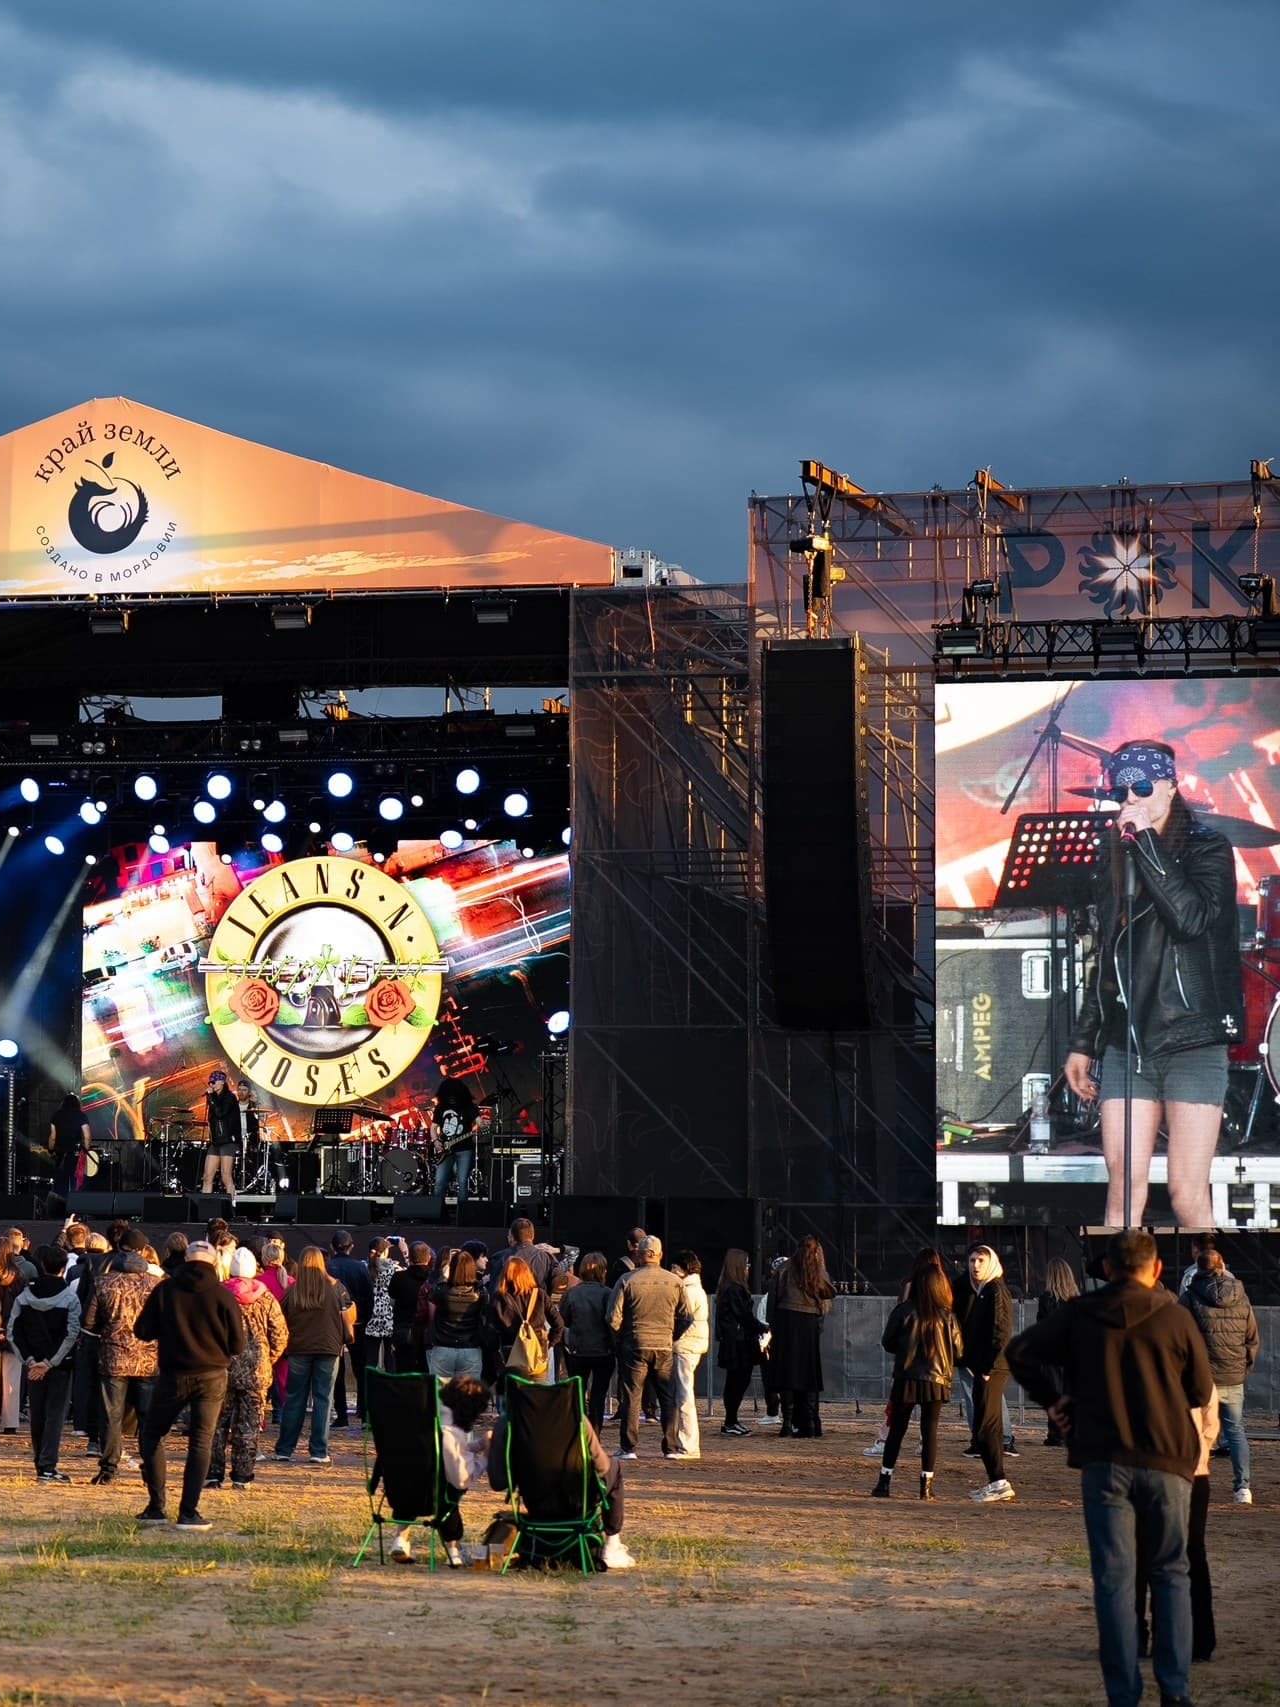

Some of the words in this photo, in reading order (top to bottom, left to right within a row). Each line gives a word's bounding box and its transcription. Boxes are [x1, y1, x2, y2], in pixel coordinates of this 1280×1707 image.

[34, 420, 97, 484] край
[104, 423, 182, 481] земли
[36, 525, 89, 581] СОЗДАНО
[94, 573, 104, 583] В
[110, 521, 177, 583] МОРДОВИИ
[242, 1037, 391, 1097] ROSES
[972, 992, 992, 1081] AMPEG
